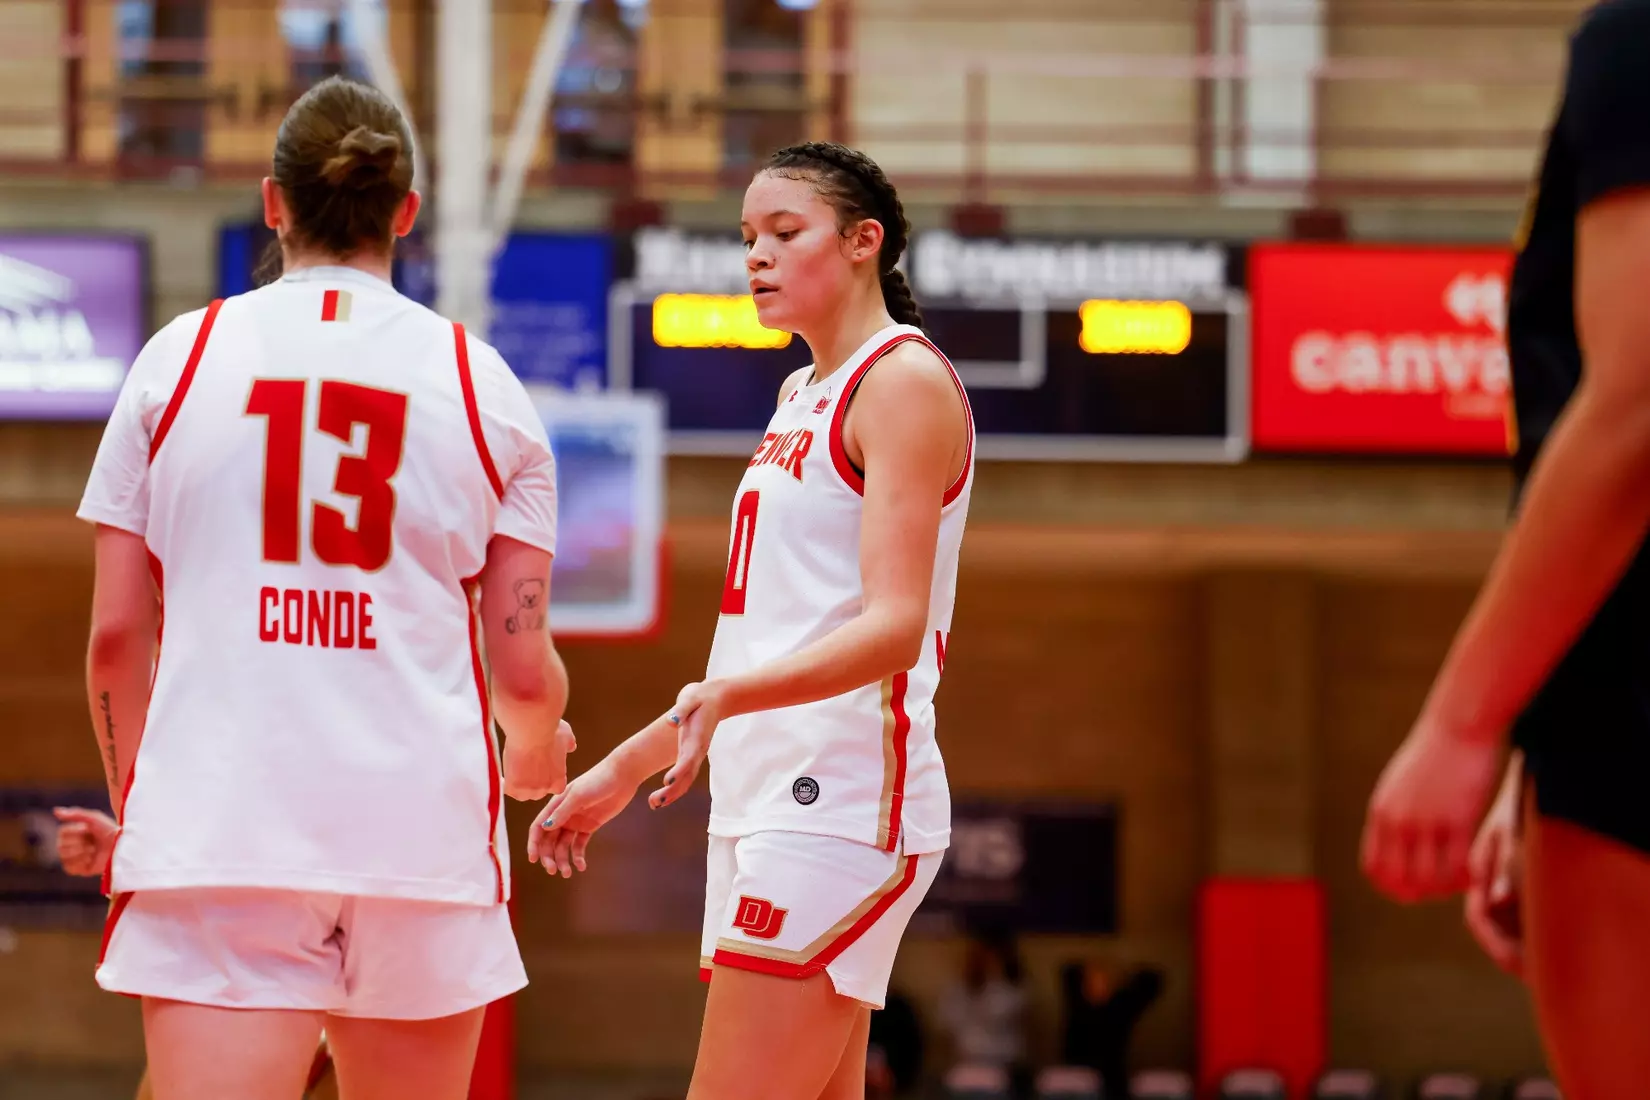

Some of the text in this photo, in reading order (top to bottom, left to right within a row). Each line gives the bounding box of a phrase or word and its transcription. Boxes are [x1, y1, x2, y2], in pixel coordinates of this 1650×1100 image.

[1291, 332, 1511, 393] canva
[243, 378, 411, 574] 13
[747, 428, 814, 484] ENVER
[259, 586, 376, 650] CONDE
